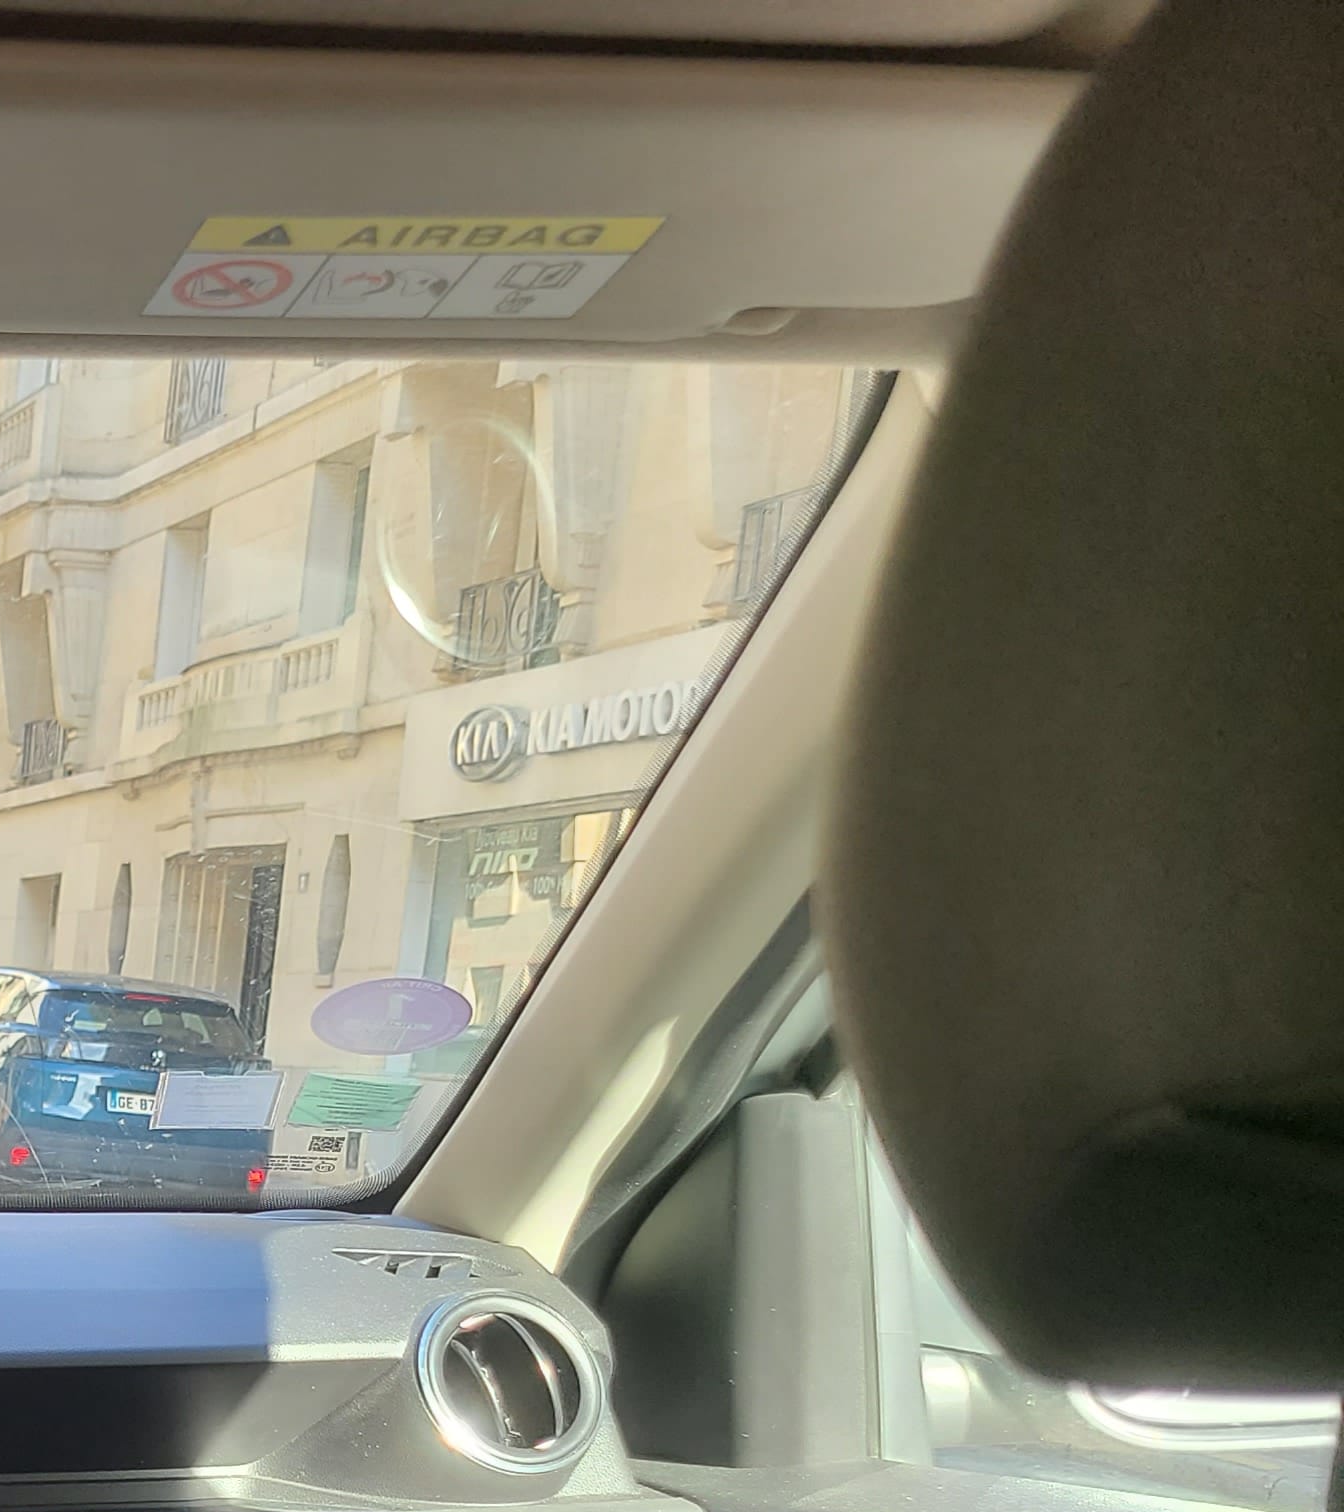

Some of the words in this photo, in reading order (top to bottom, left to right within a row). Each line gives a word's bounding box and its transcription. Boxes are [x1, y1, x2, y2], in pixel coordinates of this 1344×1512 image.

[336, 223, 607, 248] AIRBAG
[457, 720, 500, 766] KIA
[527, 704, 586, 756] KIA
